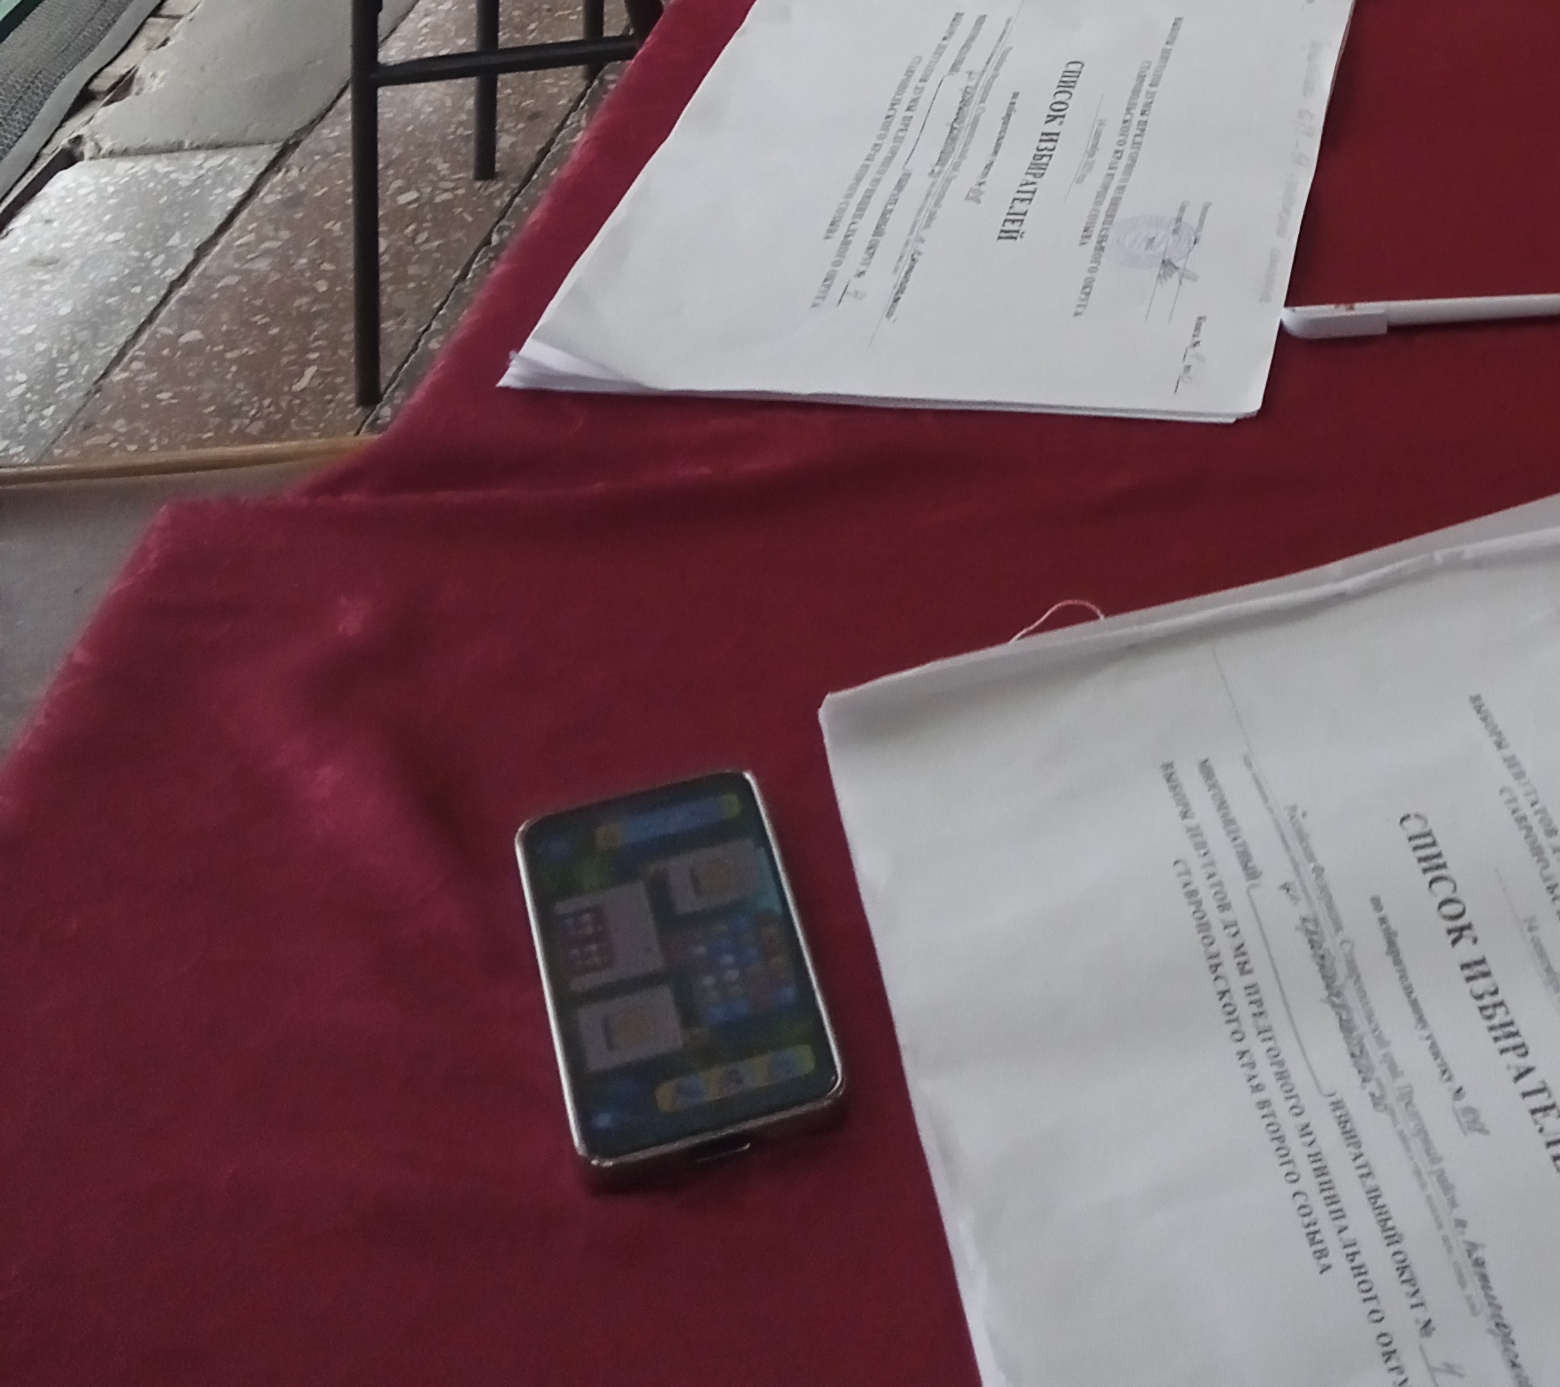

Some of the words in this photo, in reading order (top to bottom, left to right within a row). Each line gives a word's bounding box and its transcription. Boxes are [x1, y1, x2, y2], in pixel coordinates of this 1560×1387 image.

[996, 131, 1061, 241] ИЗБИРАТЕЛЕЙ
[1041, 60, 1086, 125] СПИСОК
[1395, 808, 1482, 953] СПИСОК
[1157, 759, 1196, 823] ВЫБОРЫ
[1183, 819, 1235, 915] ДЕПУТАТОВ
[1219, 916, 1256, 978] ДУМЫ
[1241, 980, 1306, 1118] ПРЕДГОРНОГО
[1293, 1121, 1388, 1326] МУНИЦИПАЛЬНОГО
[1170, 856, 1249, 1045] СТАВРОПОЛЬСКОГО
[1233, 1045, 1268, 1095] КРАЯ
[1253, 1096, 1304, 1186] ВТОРОГО
[1288, 1187, 1336, 1275] СОЗЫВА
[1327, 1097, 1405, 1248] ИЗБИРАТЕЛЬНЫЙ
[1388, 1247, 1427, 1313] ОКРУГ
[1412, 1313, 1439, 1339] №
